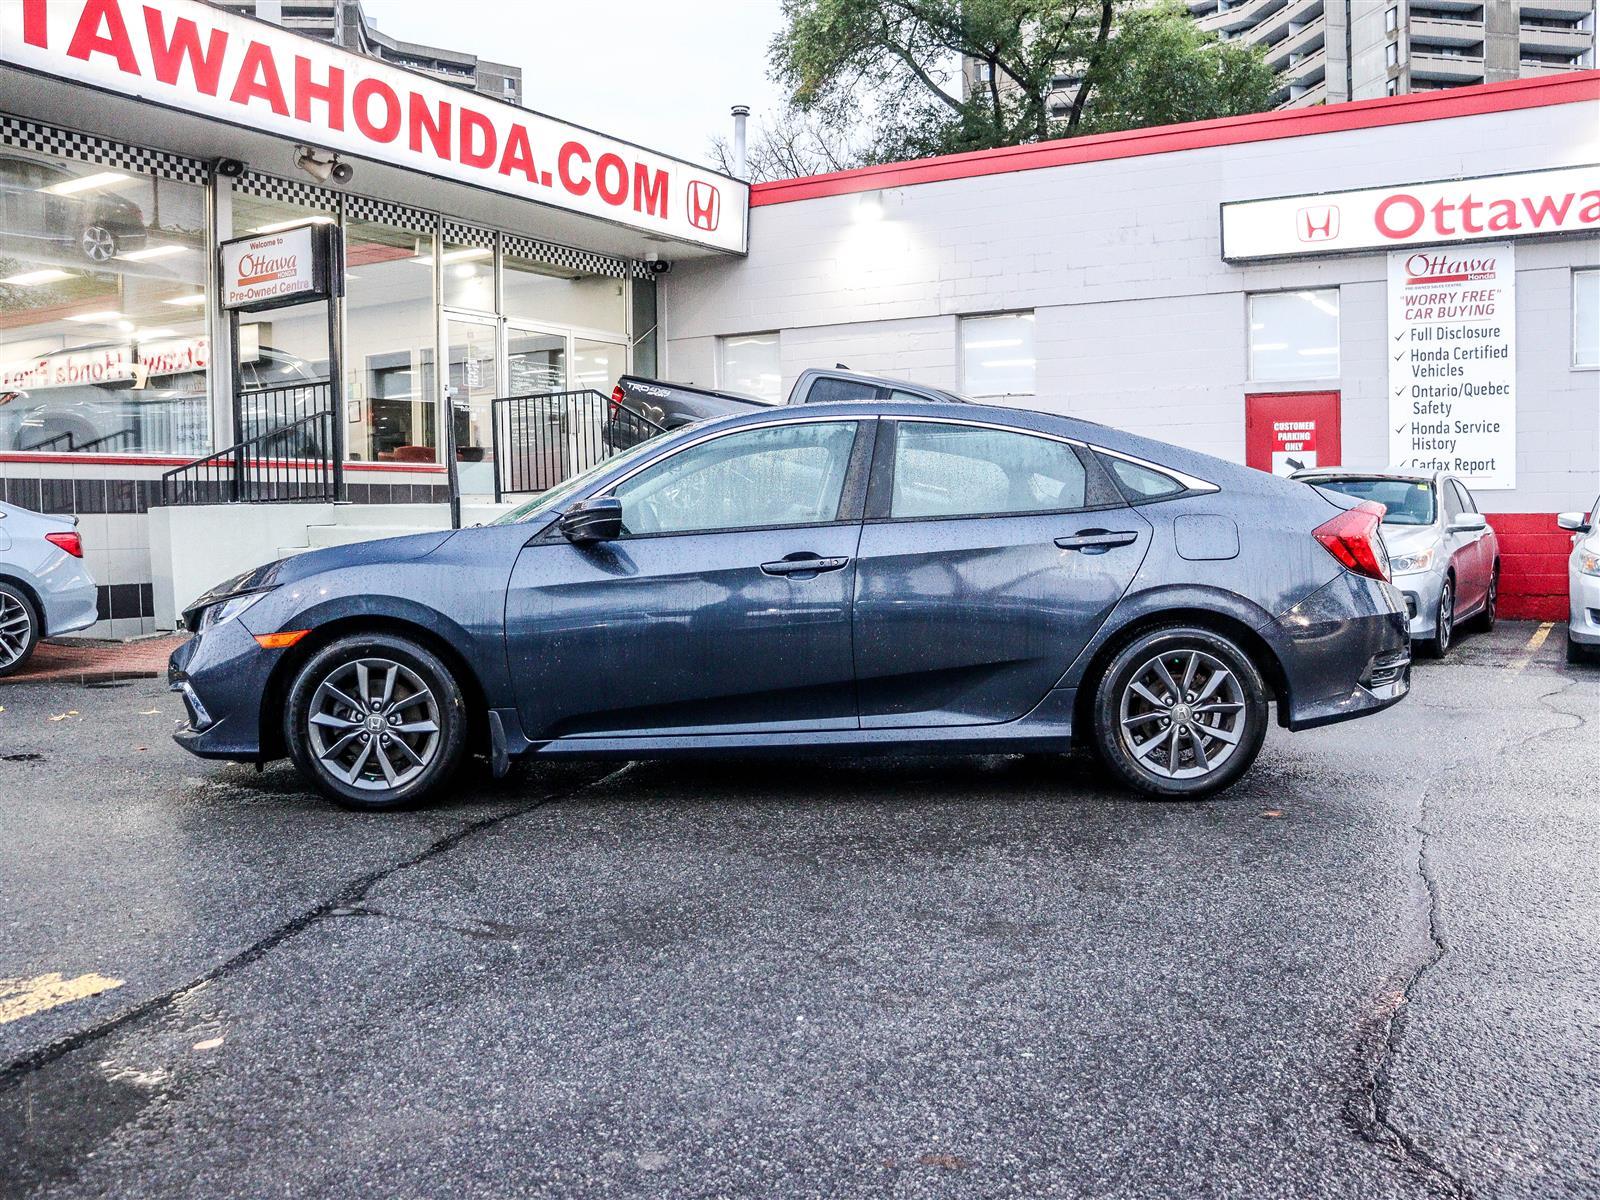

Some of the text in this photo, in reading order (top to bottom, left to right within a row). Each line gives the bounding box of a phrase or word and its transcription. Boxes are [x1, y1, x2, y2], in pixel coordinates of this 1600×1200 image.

[250, 238, 283, 250] Welcome to
[239, 253, 297, 278] Ottawa
[1405, 253, 1497, 277] Ottawa
[1467, 272, 1496, 281] Honda
[230, 280, 309, 302] Pre-Owned Centre
[1405, 303, 1495, 321] CAR BUYING
[1411, 325, 1500, 342] Full Disclosure
[1411, 343, 1508, 362] Honda Certified
[1412, 363, 1464, 378] Vehicles
[1412, 381, 1510, 398] Ontario/Quebec
[1413, 400, 1452, 418] Safety
[1273, 420, 1315, 431] CUSTOMER
[1411, 420, 1500, 435] Honda Service
[1278, 432, 1311, 441] PARKING
[1285, 442, 1303, 451] ONLY
[1412, 437, 1457, 454] History
[1454, 457, 1496, 475] Report
